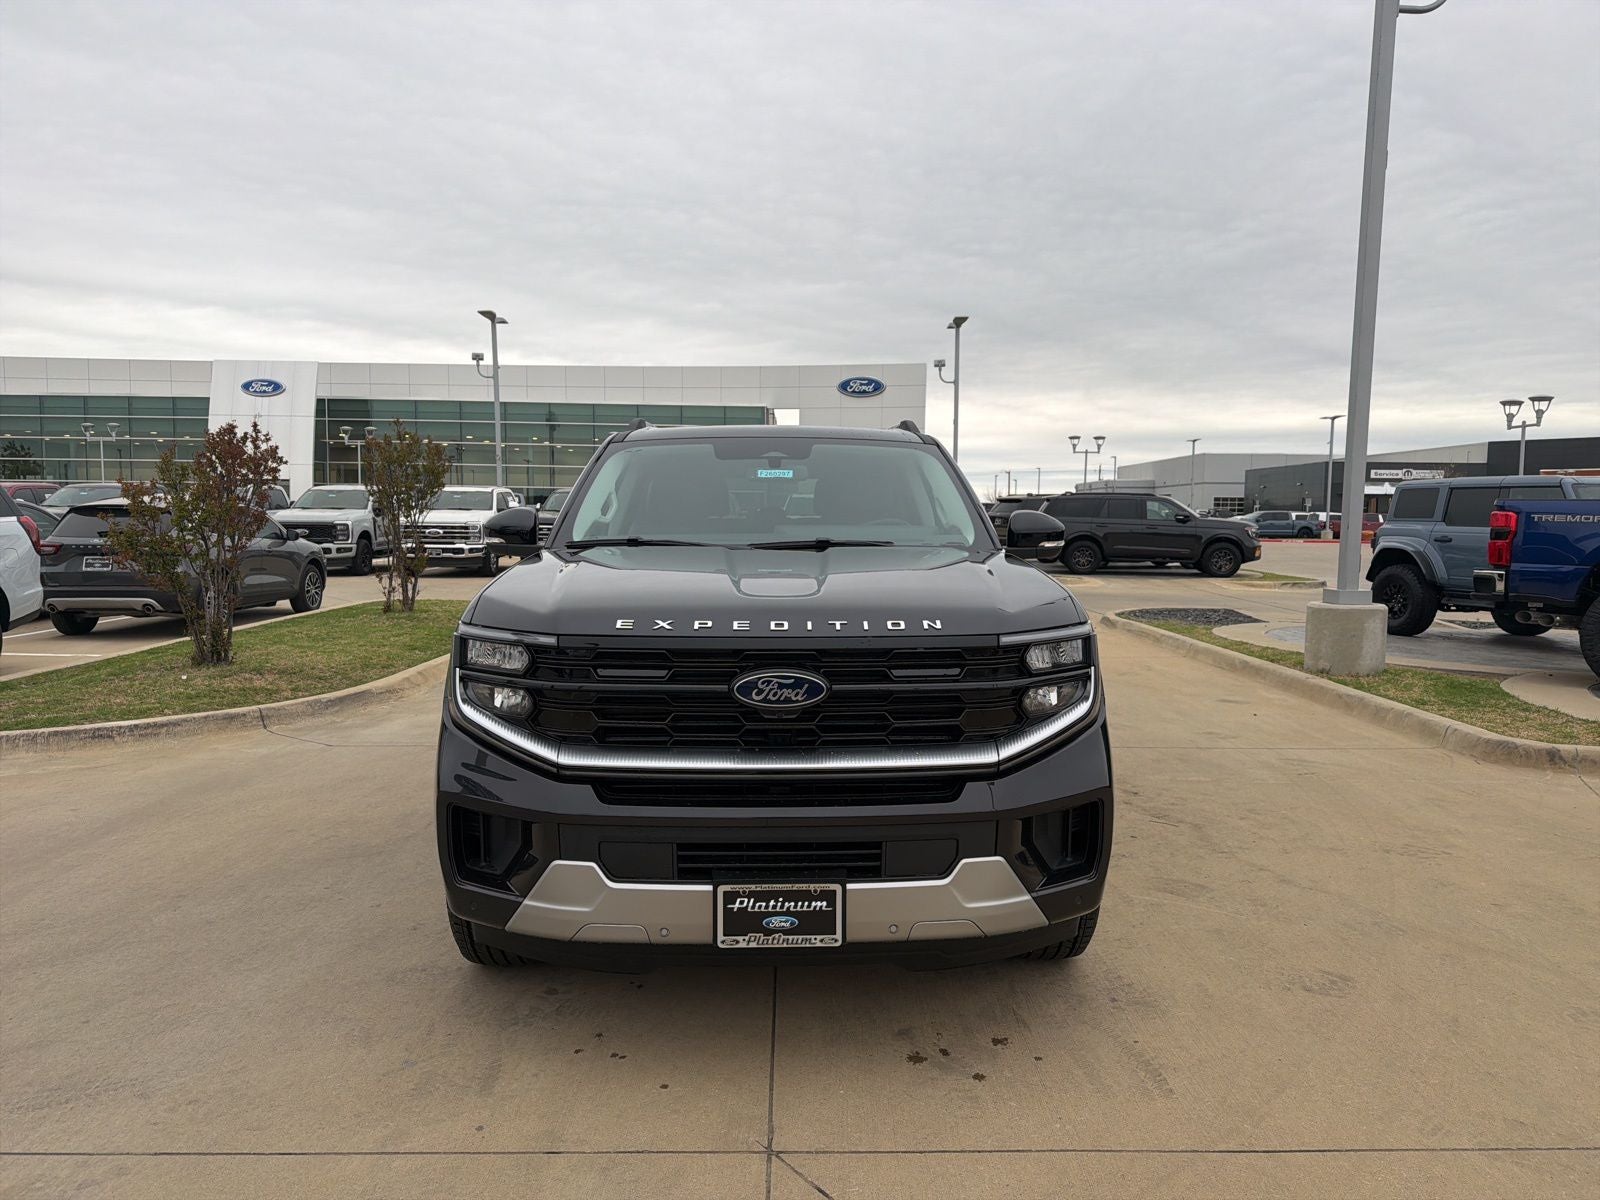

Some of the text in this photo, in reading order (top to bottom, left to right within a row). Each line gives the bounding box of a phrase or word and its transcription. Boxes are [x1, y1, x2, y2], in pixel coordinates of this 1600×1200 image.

[249, 381, 274, 391] Ford
[847, 380, 875, 392] Ford
[615, 619, 942, 631] EXPEDITION
[752, 678, 808, 701] Ford
[727, 897, 832, 912] Platinum
[769, 918, 791, 928] Ford
[745, 933, 818, 946] Platinum
